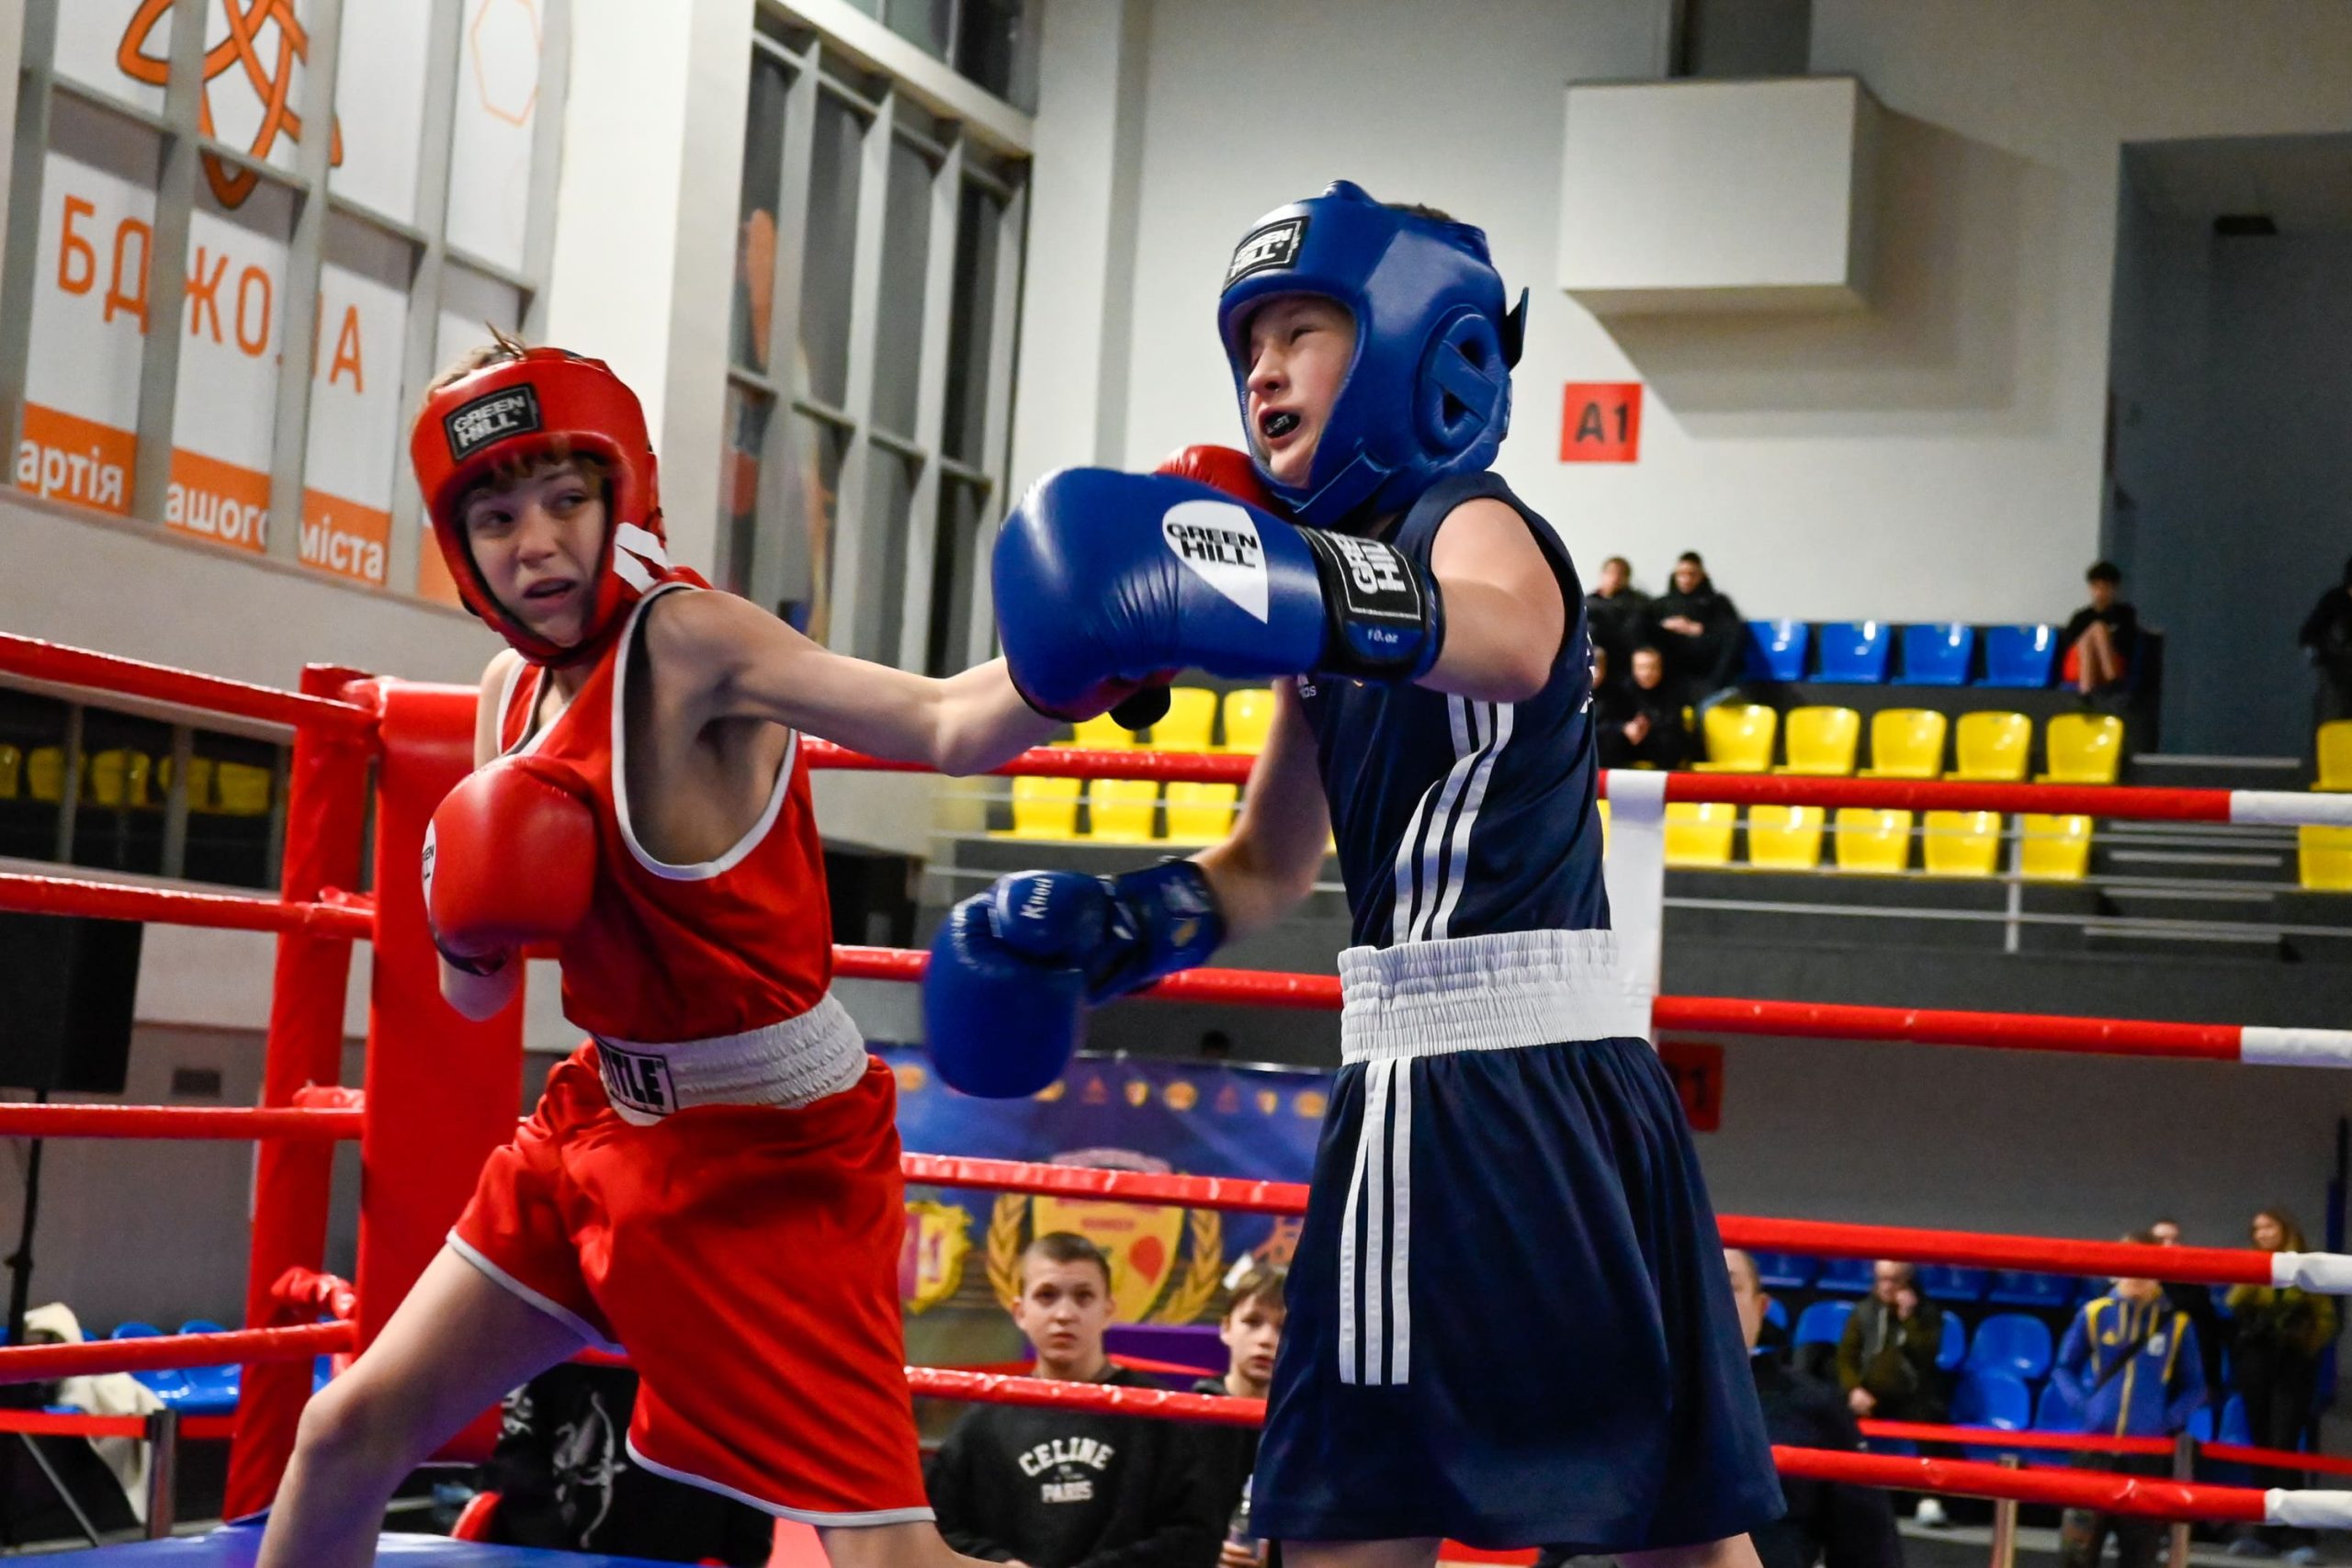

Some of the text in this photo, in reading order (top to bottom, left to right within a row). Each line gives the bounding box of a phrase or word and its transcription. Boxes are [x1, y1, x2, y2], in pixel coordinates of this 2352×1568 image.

[57, 193, 364, 394] БДЖОА
[453, 395, 526, 433] GREEN
[458, 412, 519, 448] HILL
[1575, 401, 1629, 443] A1
[17, 439, 124, 505] артія
[164, 482, 268, 547] ашог
[1166, 523, 1258, 550] GREEN
[1180, 539, 1256, 568] HILL
[1018, 1436, 1115, 1477] CELINE
